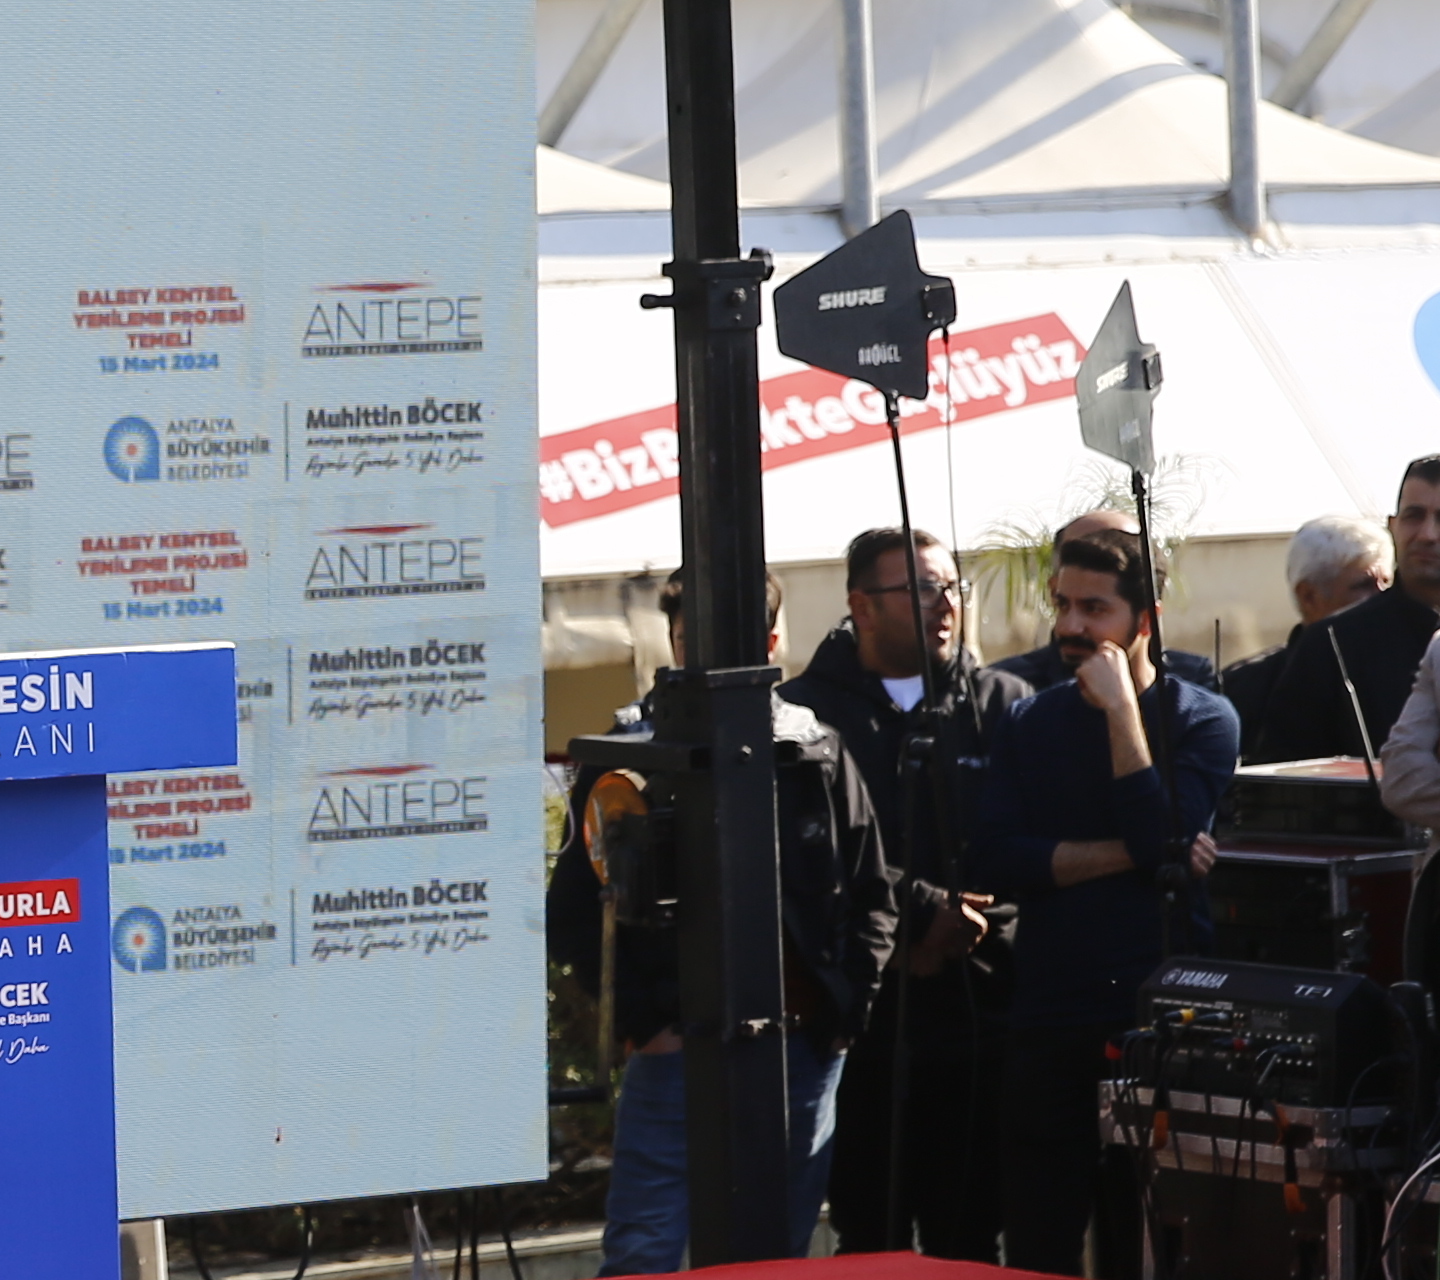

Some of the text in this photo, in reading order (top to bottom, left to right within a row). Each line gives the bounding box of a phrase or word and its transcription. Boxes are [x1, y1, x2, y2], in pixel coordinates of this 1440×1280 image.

[818, 287, 888, 310] SHURE
[303, 296, 482, 343] ANTEPE
[167, 419, 235, 435] ANTALYA
[306, 398, 482, 431] Muhittin BÖCEK
[167, 433, 270, 459] BÜYÜKŞEHİR
[306, 538, 485, 585] ANTEPE
[309, 639, 486, 673] Muhittin BÖCEK
[309, 777, 487, 831] ANTEPE
[313, 879, 488, 915] Muhittin BÖCEK
[1176, 971, 1228, 989] YAMAHA
[8, 1012, 50, 1026] Başkanı
[6, 1036, 50, 1063] Daha
